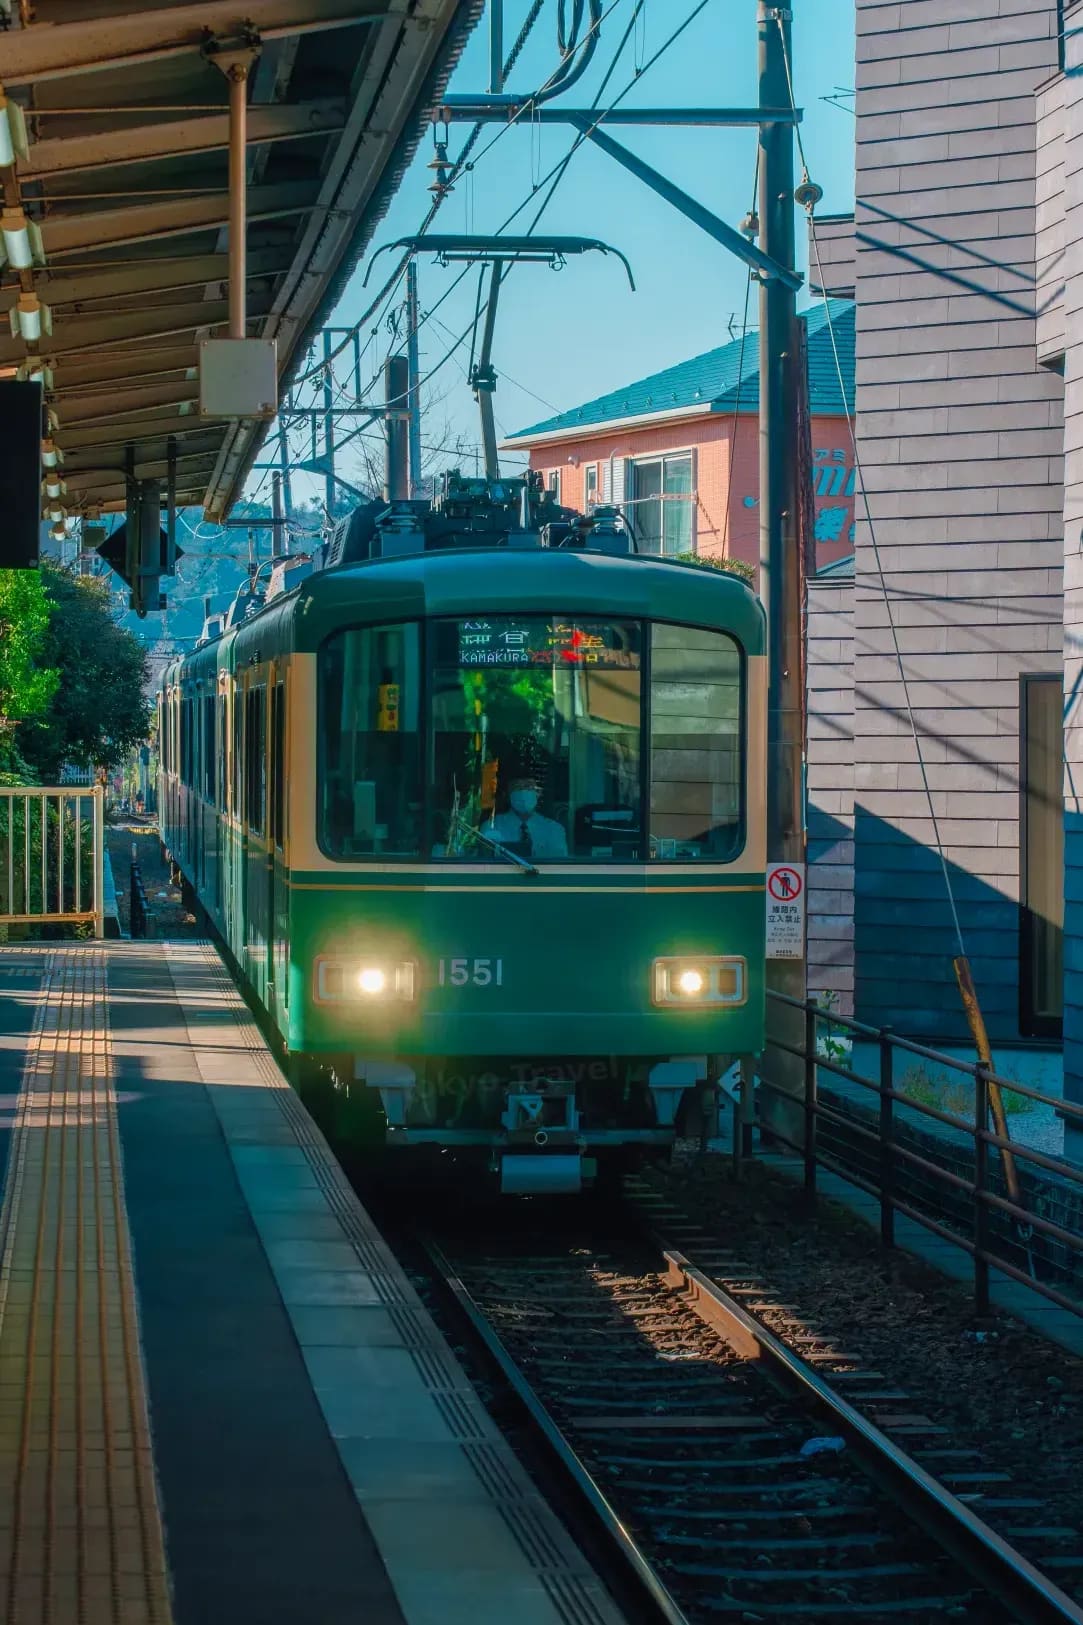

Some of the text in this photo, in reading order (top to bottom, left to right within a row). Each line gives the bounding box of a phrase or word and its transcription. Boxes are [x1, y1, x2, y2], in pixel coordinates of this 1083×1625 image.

[461, 652, 529, 663] KAMAKURA
[768, 915, 801, 923] 立入禁止
[439, 959, 502, 986] 1551
